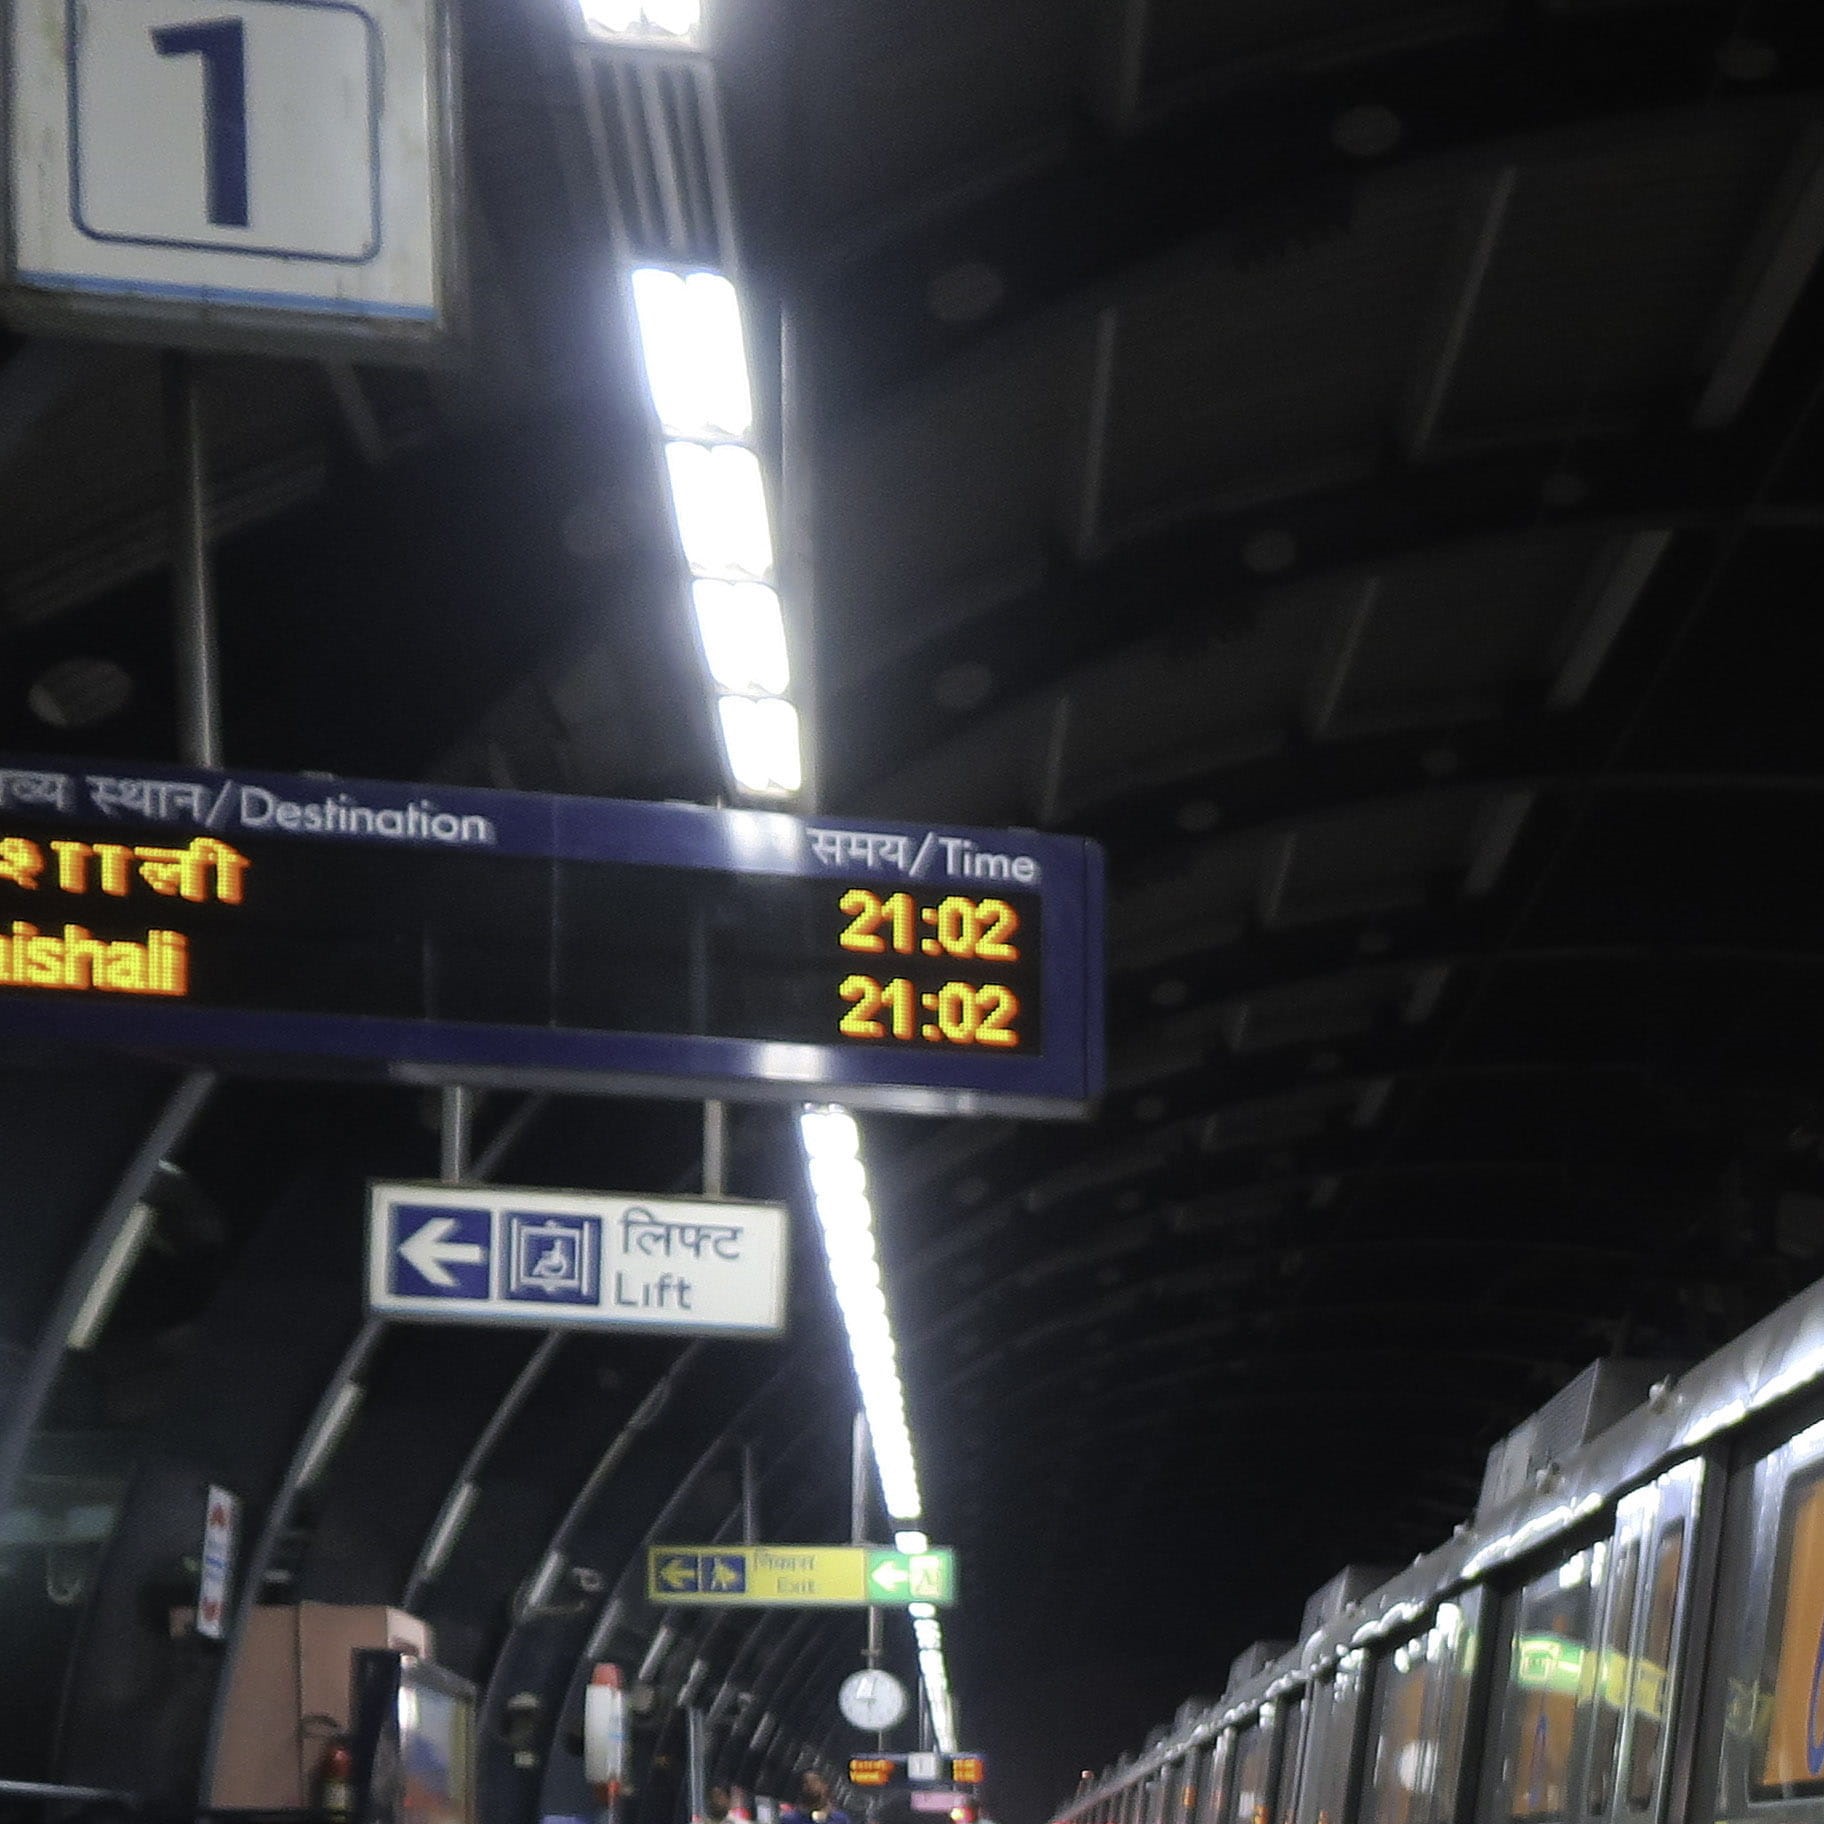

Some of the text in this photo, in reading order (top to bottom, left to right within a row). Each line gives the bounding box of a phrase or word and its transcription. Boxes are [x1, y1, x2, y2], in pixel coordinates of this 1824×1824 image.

[150, 15, 249, 228] 1
[0, 768, 70, 813] व्य
[0, 920, 190, 997] ishali
[838, 887, 1021, 963] 21:02
[838, 974, 1021, 1048] 21:02
[619, 1205, 744, 1261] लिफ्ट
[613, 1270, 693, 1310] Lift
